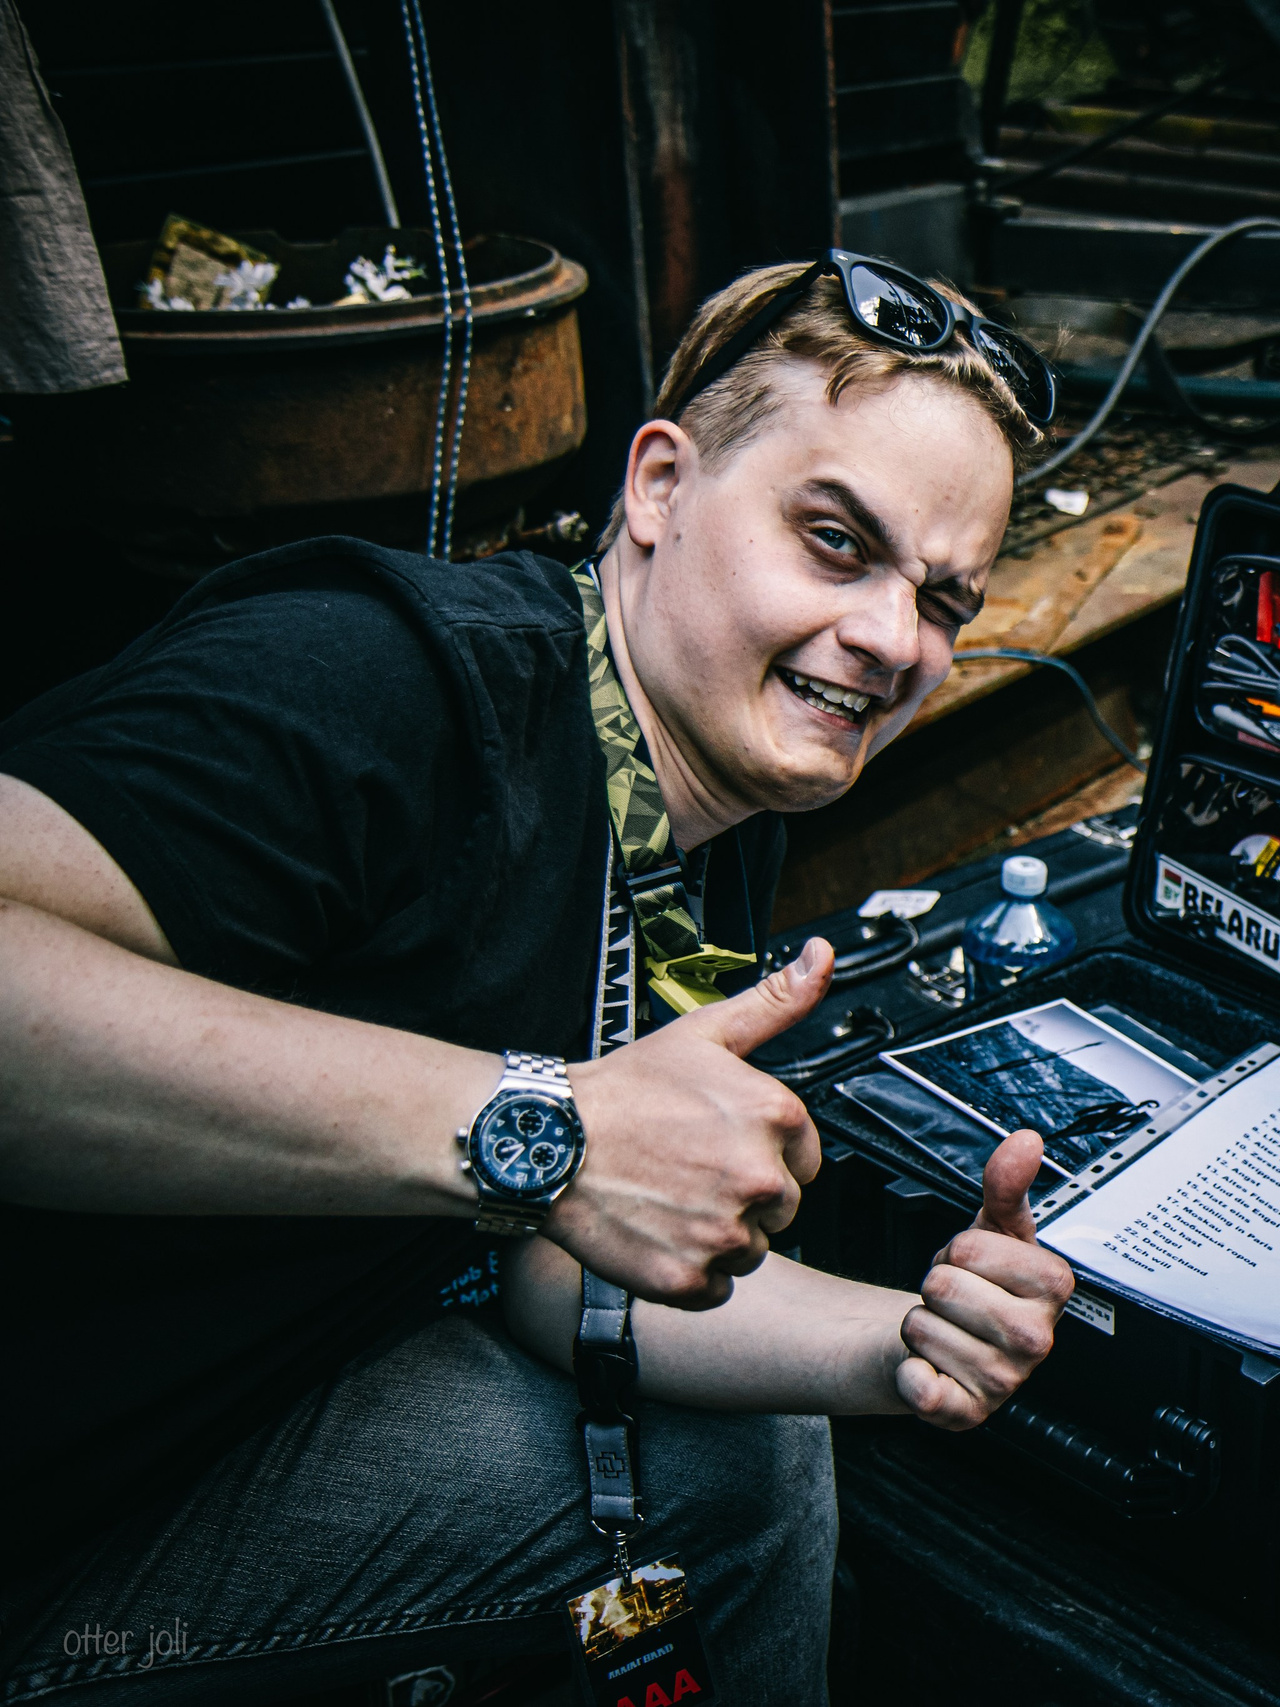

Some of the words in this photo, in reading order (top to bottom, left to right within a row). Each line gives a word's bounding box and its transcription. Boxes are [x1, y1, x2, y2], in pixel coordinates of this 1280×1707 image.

[1254, 1141, 1278, 1157] Alter
[1222, 1176, 1248, 1193] Altes
[1231, 1168, 1260, 1187] Angst
[1202, 1191, 1228, 1208] Platz
[1230, 1208, 1250, 1224] eins
[1213, 1183, 1233, 1197] Und
[1234, 1197, 1250, 1208] die
[1252, 1208, 1280, 1228] Engel
[1183, 1207, 1222, 1233] Moskau
[1152, 1230, 1183, 1250] Engel
[1162, 1222, 1177, 1233] Du
[1179, 1232, 1203, 1248] hast
[1172, 1214, 1225, 1248] Любимый
[1226, 1248, 1257, 1268] город
[1235, 1226, 1245, 1234] in
[1247, 1233, 1274, 1251] Paris
[1121, 1252, 1155, 1273] Sonne
[1132, 1245, 1149, 1257] Ich
[1151, 1256, 1172, 1270] will
[1142, 1237, 1209, 1277] Deutschland
